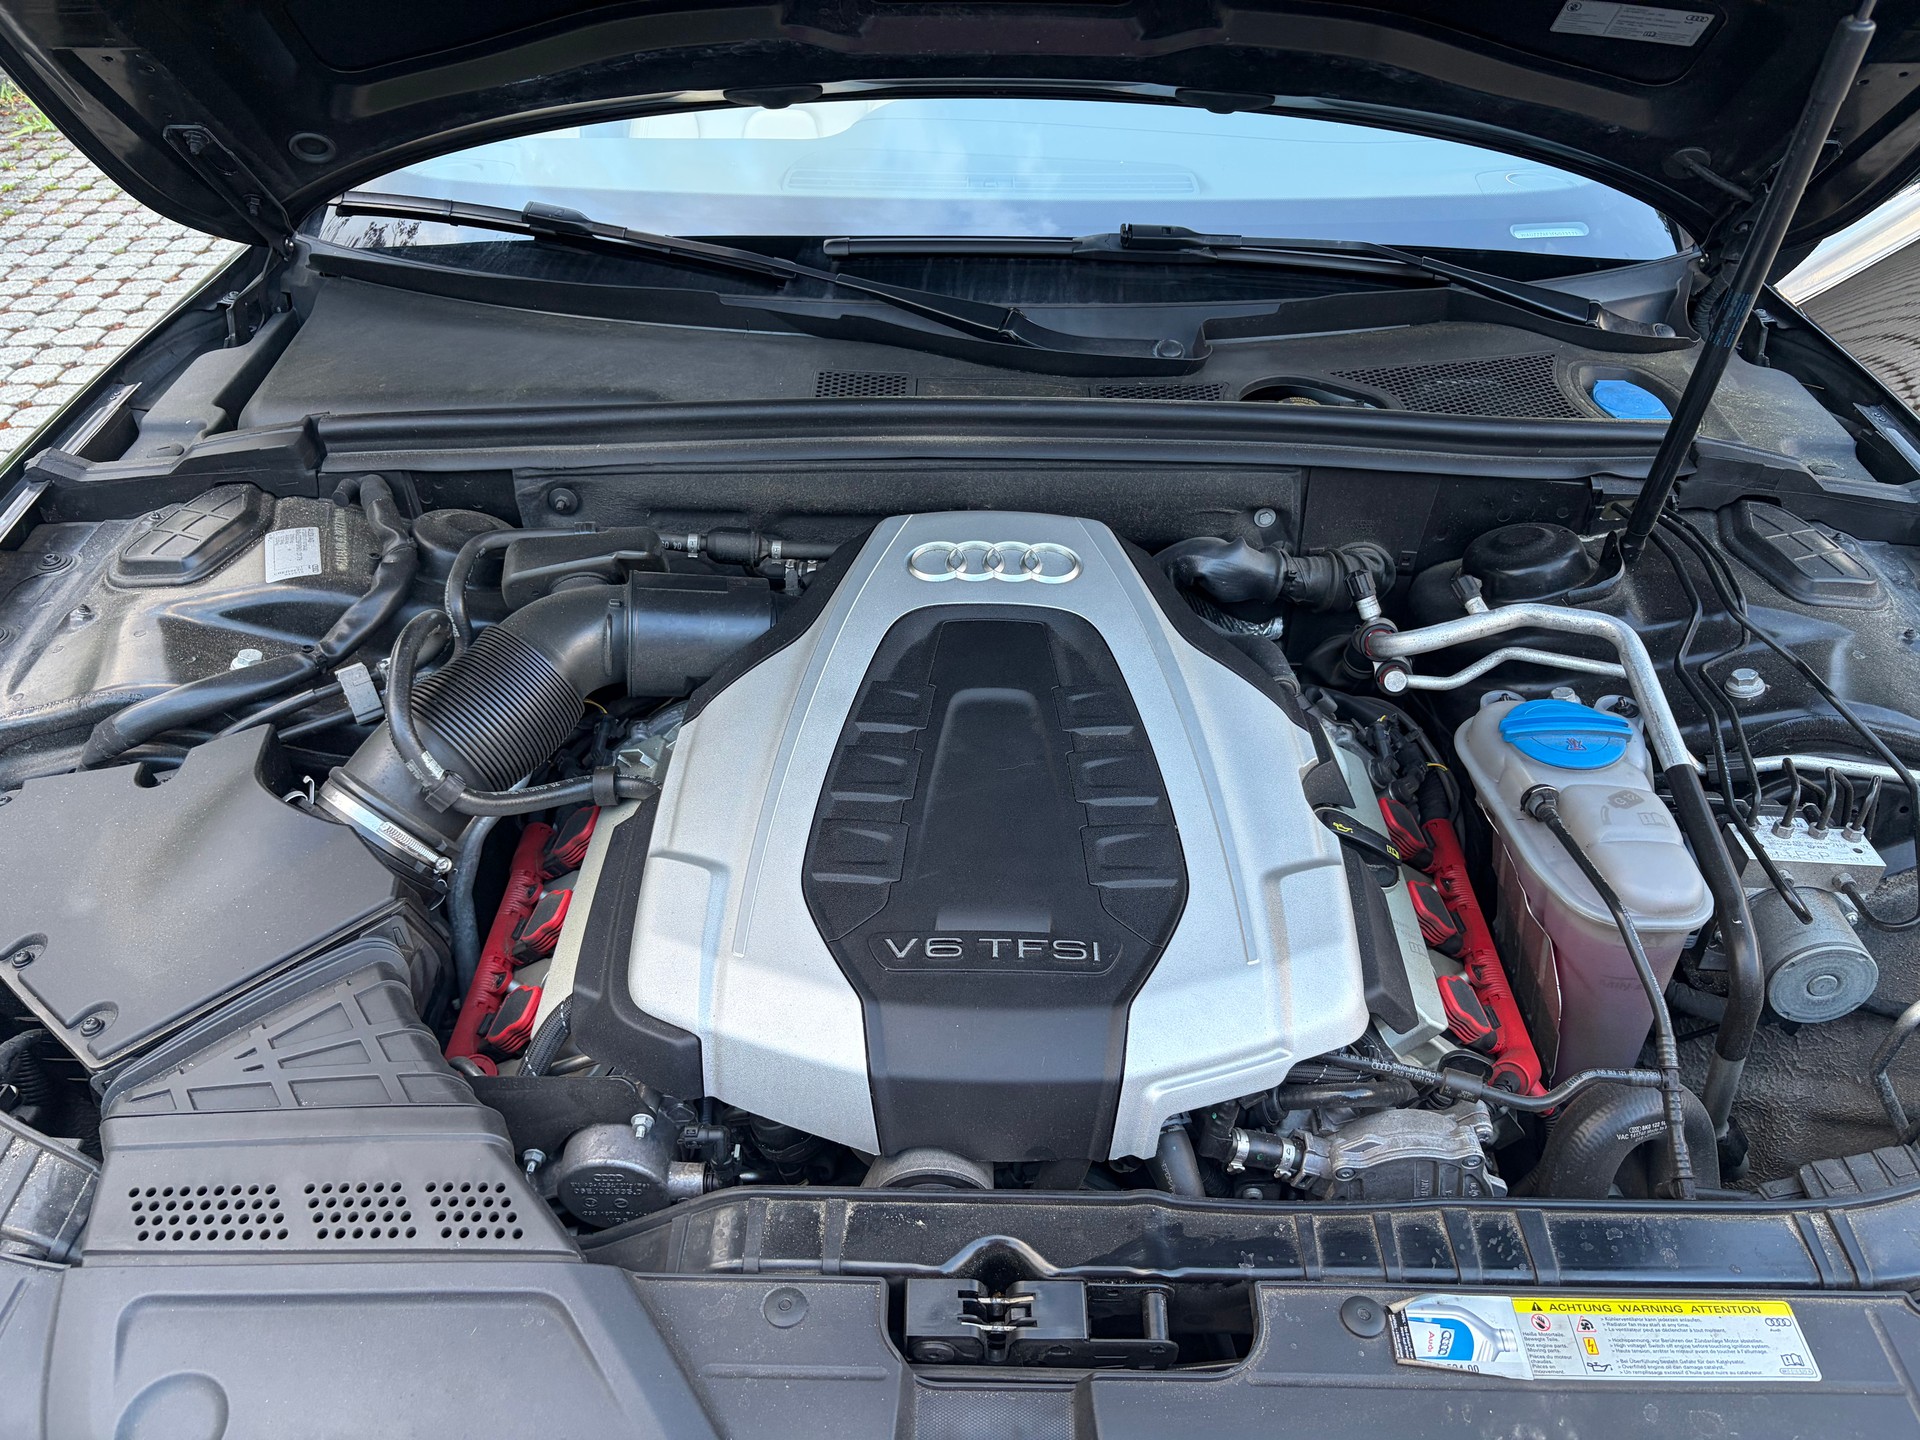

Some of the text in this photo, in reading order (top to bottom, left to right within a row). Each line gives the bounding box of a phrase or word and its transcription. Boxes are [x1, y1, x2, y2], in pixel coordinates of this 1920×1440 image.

[885, 937, 1101, 963] V6 TFSI
[1549, 1303, 1762, 1314] ACHTUNG WARNING ATTENTION
